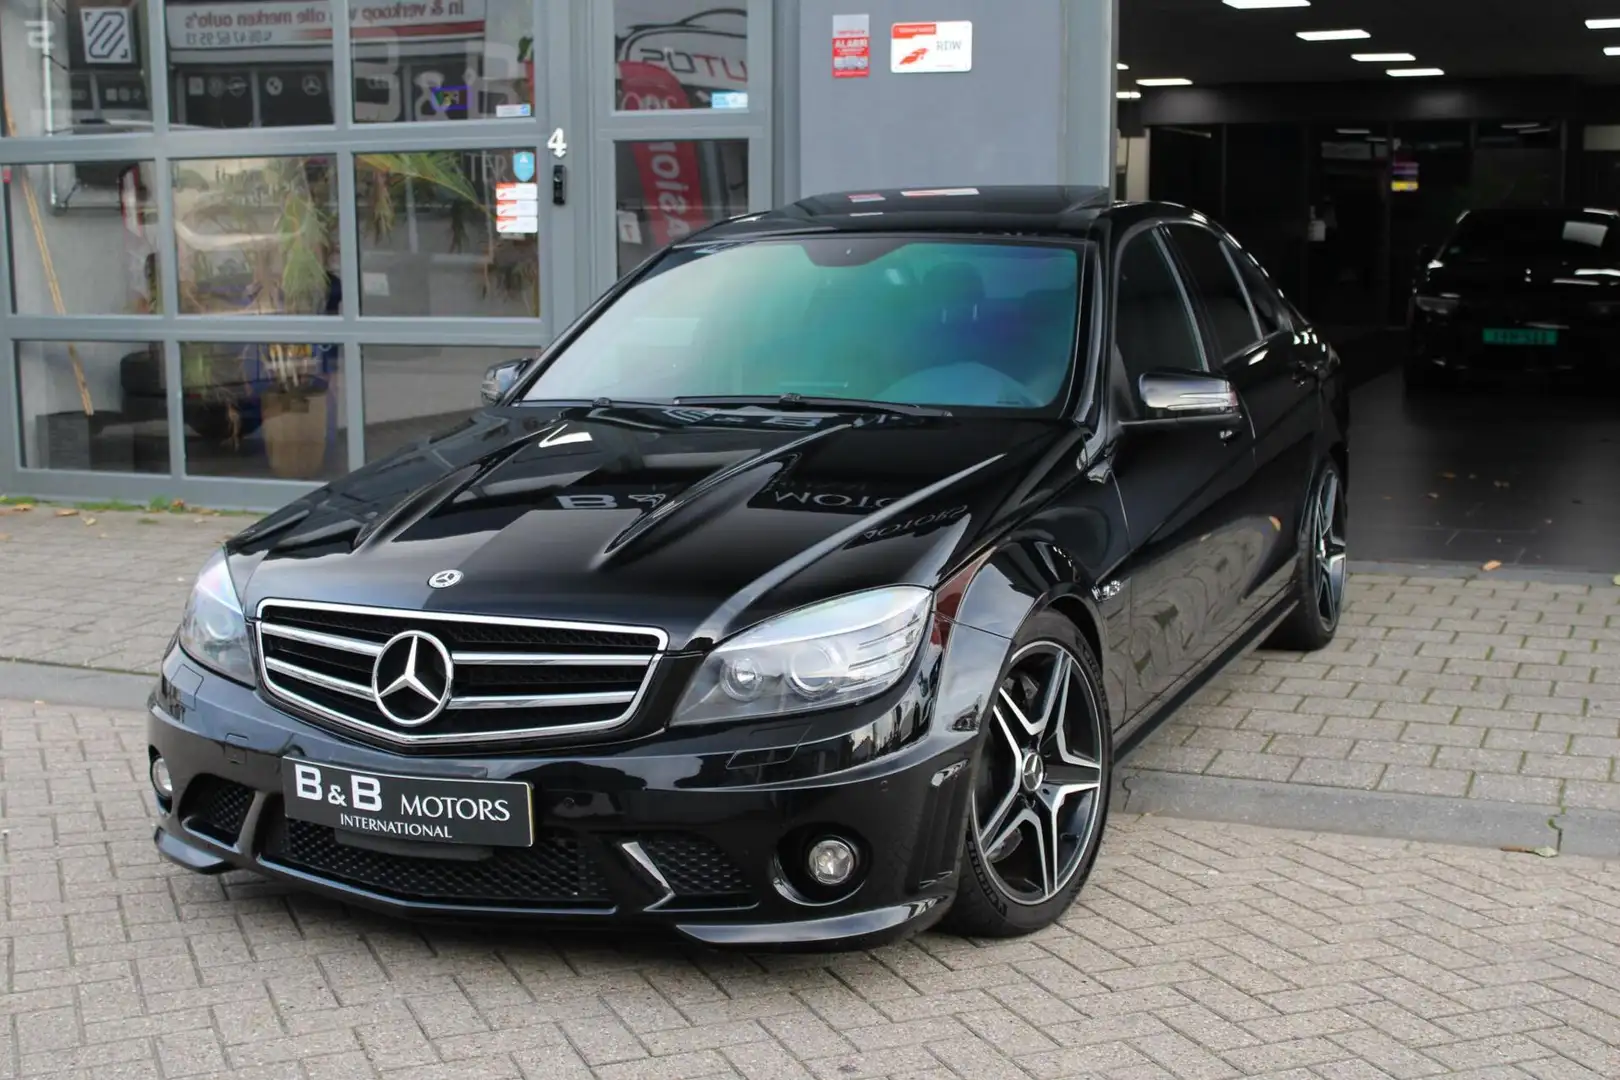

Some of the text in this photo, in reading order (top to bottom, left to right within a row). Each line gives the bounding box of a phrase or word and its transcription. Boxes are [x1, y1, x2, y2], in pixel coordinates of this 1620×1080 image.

[935, 40, 962, 52] RDW
[547, 127, 567, 158] 4
[400, 793, 511, 822] MOTORS
[340, 812, 453, 839] INTERNATIONAL
